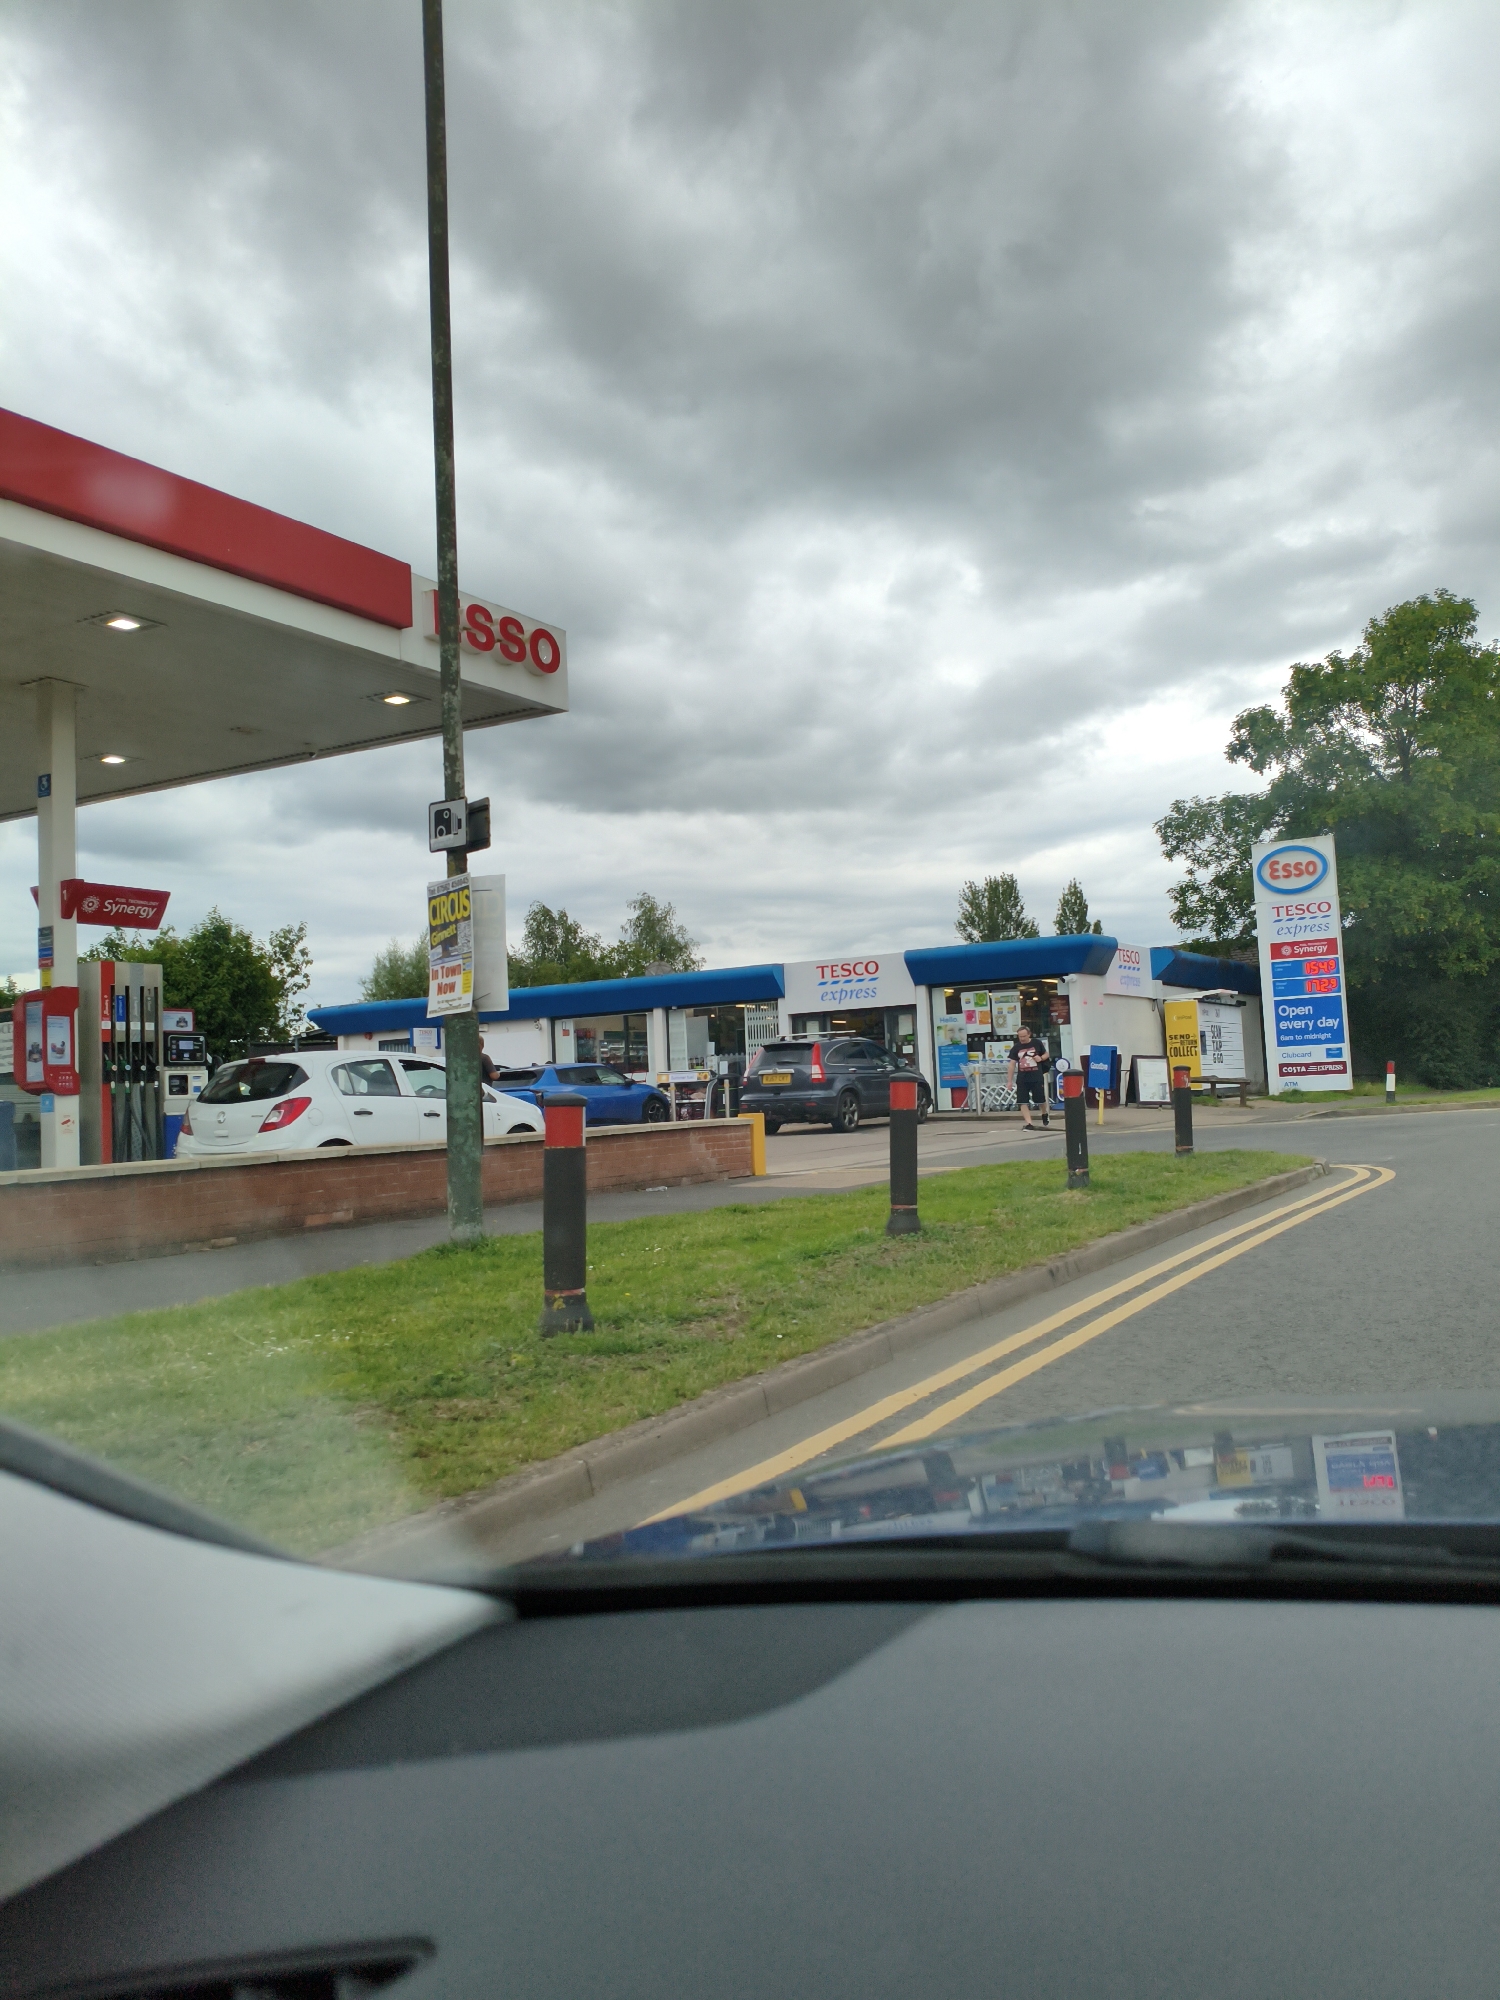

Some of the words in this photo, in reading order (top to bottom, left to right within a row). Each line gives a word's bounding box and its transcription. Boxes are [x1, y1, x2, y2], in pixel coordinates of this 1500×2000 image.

[433, 589, 561, 674] SSO
[62, 890, 67, 900] 1
[102, 900, 157, 918] Synergy
[430, 889, 470, 926] CIRCUS
[1272, 902, 1332, 918] TESCO
[1276, 922, 1330, 937] express
[1117, 948, 1140, 964] TESCO
[1294, 945, 1328, 955] Synergy
[431, 967, 439, 981] In
[440, 964, 462, 979] Town
[816, 960, 880, 979] TESCO
[437, 981, 456, 996] Now
[1120, 974, 1140, 990] express
[820, 986, 877, 1004] express
[1278, 1005, 1313, 1018] Open
[1280, 1020, 1314, 1031] every
[1317, 1016, 1340, 1030] day
[1210, 1025, 1222, 1039] SCAN
[1304, 1032, 1332, 1040] midnight
[1170, 1046, 1198, 1058] COLLECT
[1212, 1040, 1222, 1052] TAP
